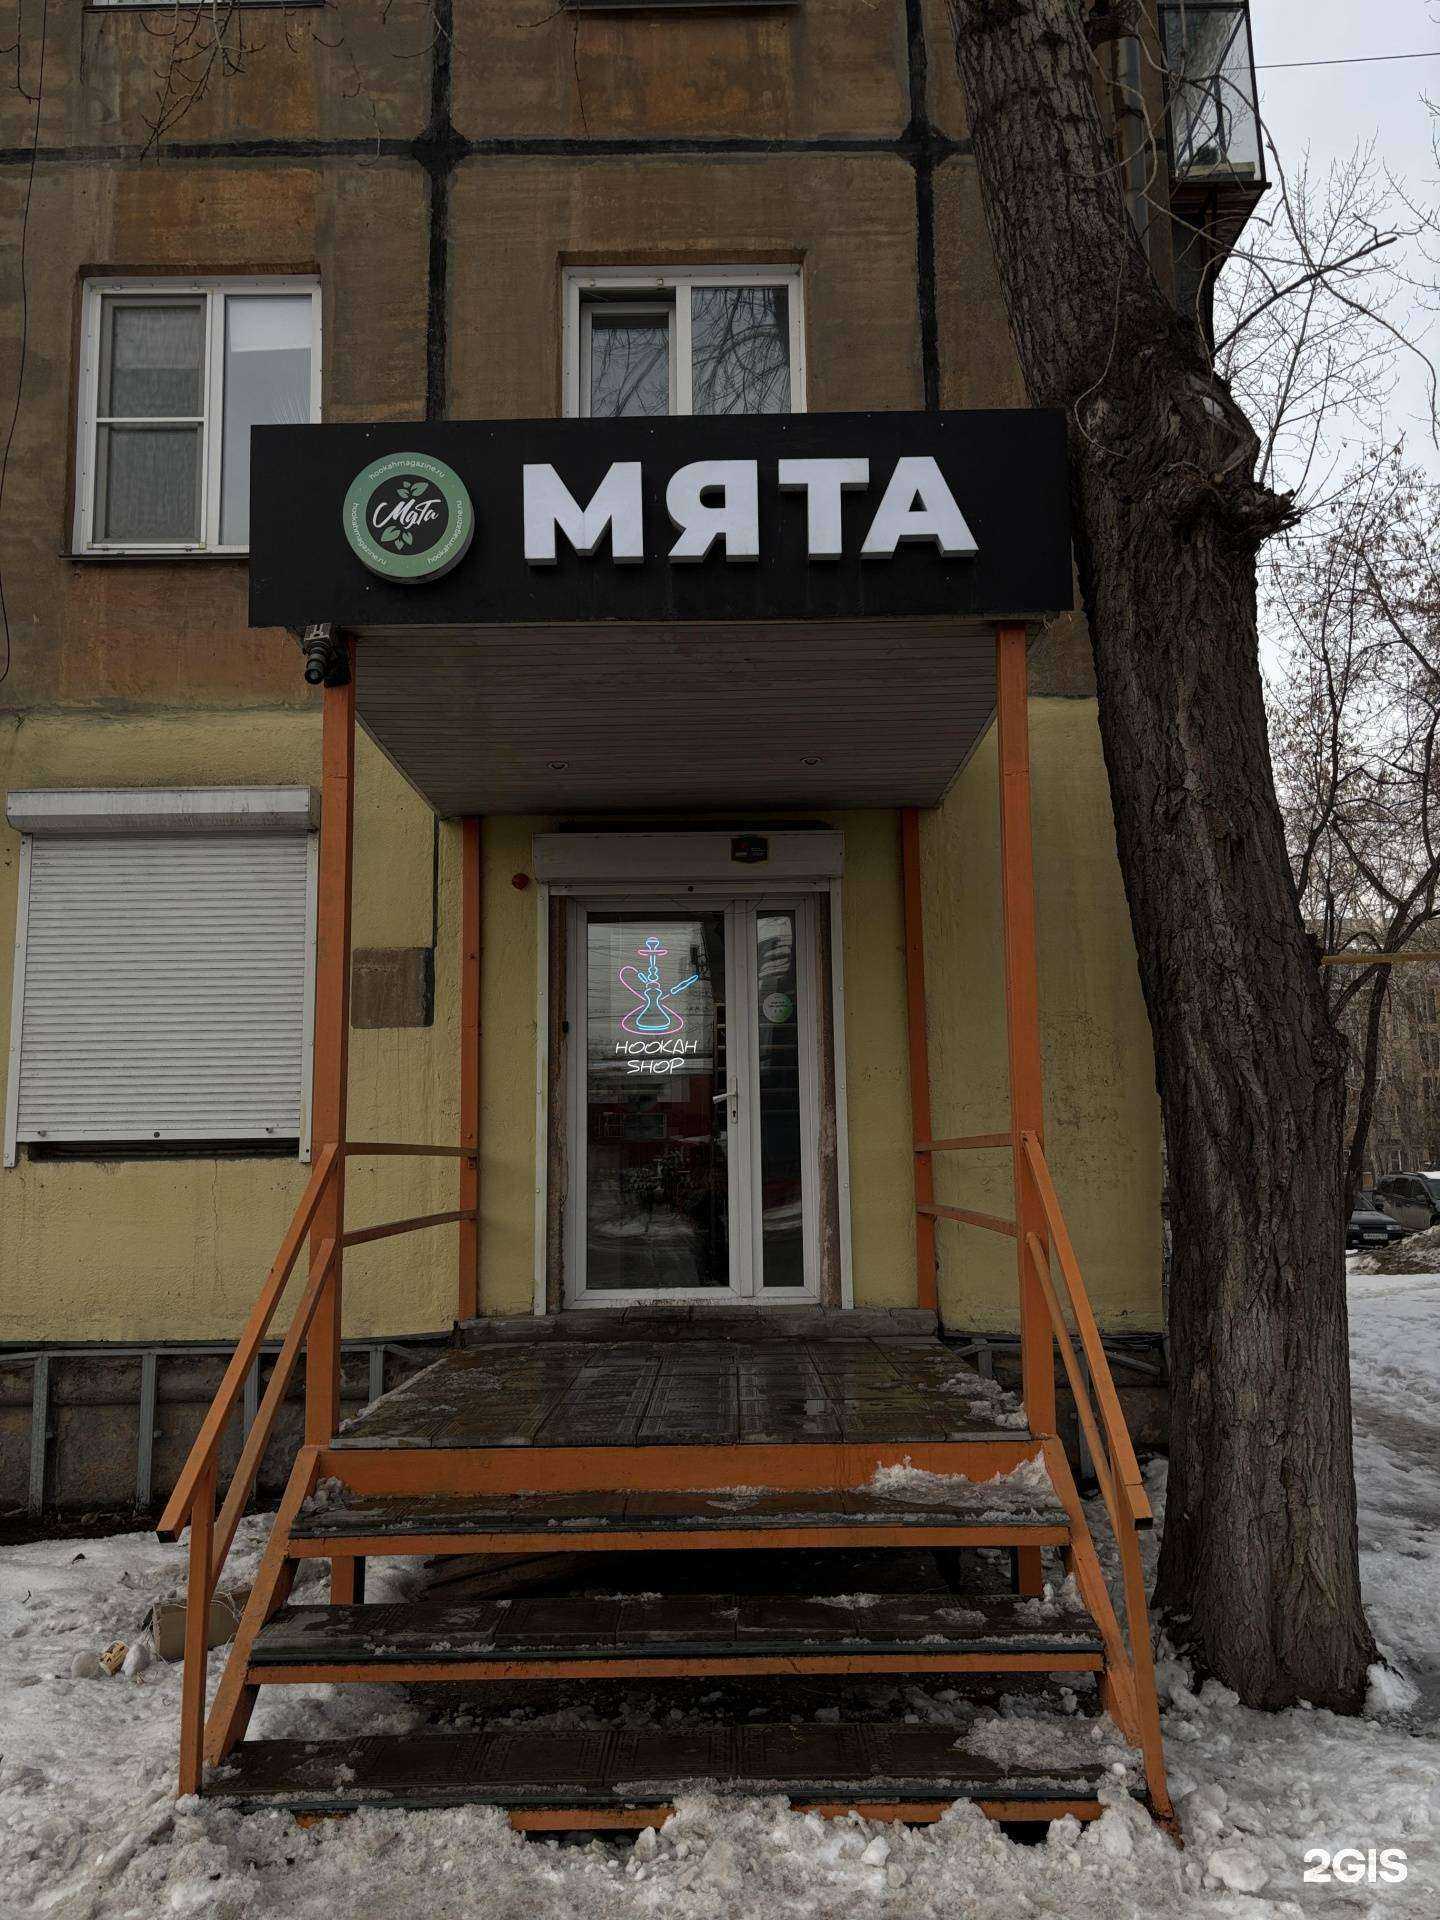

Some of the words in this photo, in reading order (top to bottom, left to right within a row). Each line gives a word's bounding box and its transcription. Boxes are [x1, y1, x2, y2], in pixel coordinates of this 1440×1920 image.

[523, 456, 979, 567] МЯТА
[615, 1039, 697, 1055] HOOKAH
[627, 1058, 684, 1074] SHOP
